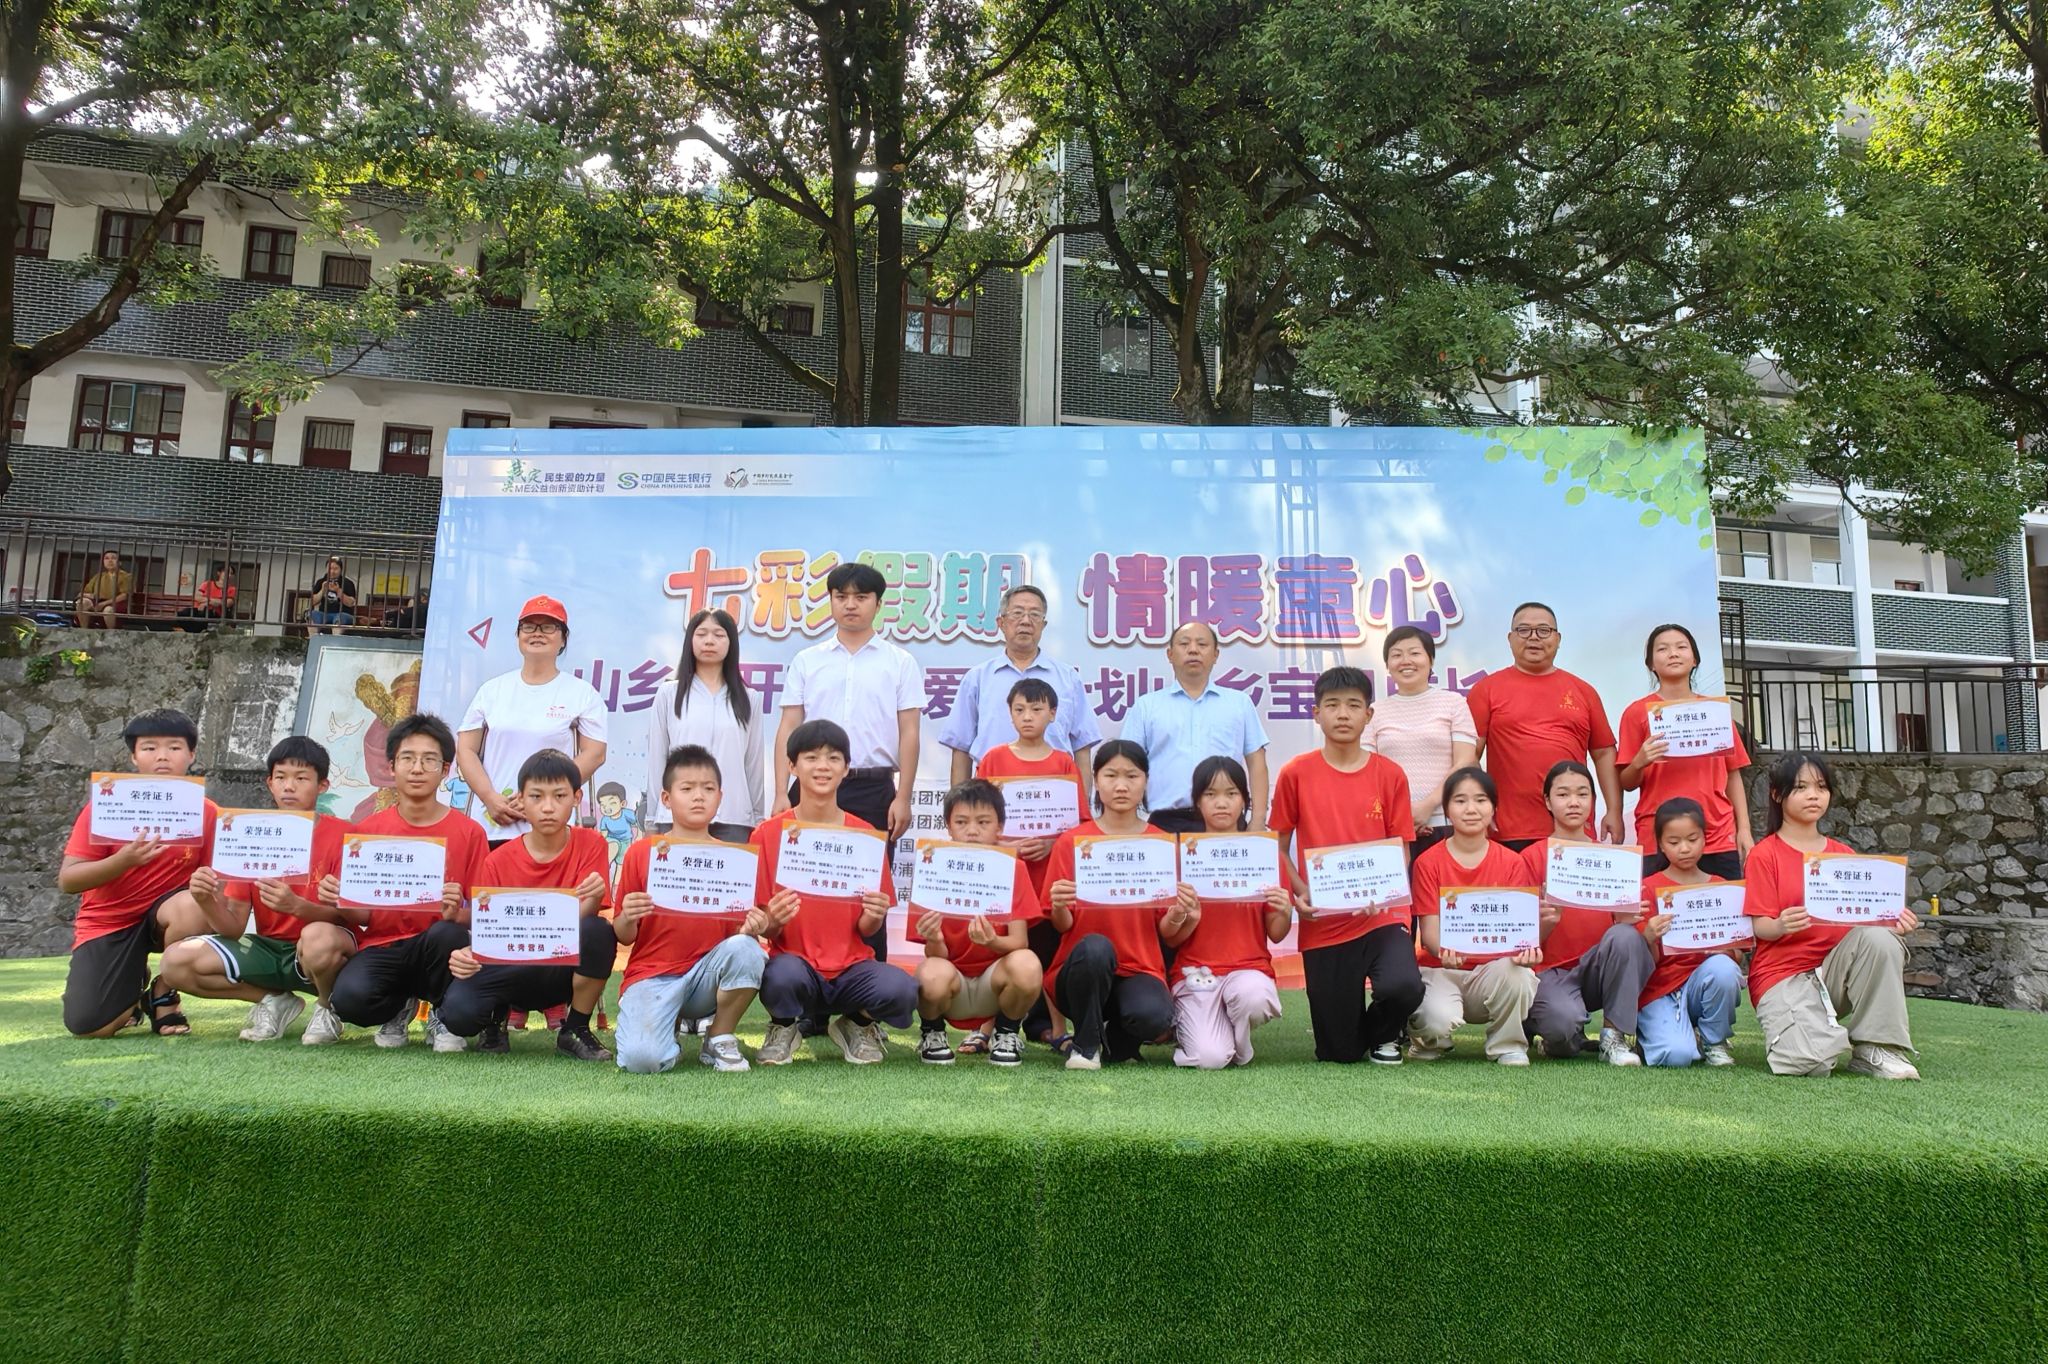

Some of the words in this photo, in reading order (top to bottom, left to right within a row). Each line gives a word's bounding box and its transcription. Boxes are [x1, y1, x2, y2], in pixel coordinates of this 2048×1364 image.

[544, 472, 605, 482] 民生爱的力量
[641, 473, 711, 483] 中国民生银行
[666, 548, 1030, 640] 七彩假期
[1082, 552, 1460, 640] 情暖童心
[1674, 712, 1707, 722] 荣誉证书
[130, 790, 173, 801] 荣誉证书
[1016, 790, 1051, 800] 荣誉证书
[244, 826, 282, 836] 荣誉证书
[813, 841, 853, 855] 荣誉证书
[1210, 848, 1249, 858] 荣誉证书
[374, 852, 414, 863] 荣誉证书
[682, 856, 724, 869] 荣誉证书
[1106, 852, 1145, 862] 荣誉证书
[946, 859, 985, 872] 荣誉证书
[1337, 858, 1375, 871] 荣誉证书
[1576, 857, 1612, 869] 荣誉证书
[1833, 870, 1872, 881] 荣誉证书
[1470, 903, 1509, 913] 荣誉证书
[1686, 898, 1722, 909] 荣誉证书
[504, 905, 546, 916] 荣誉证书
